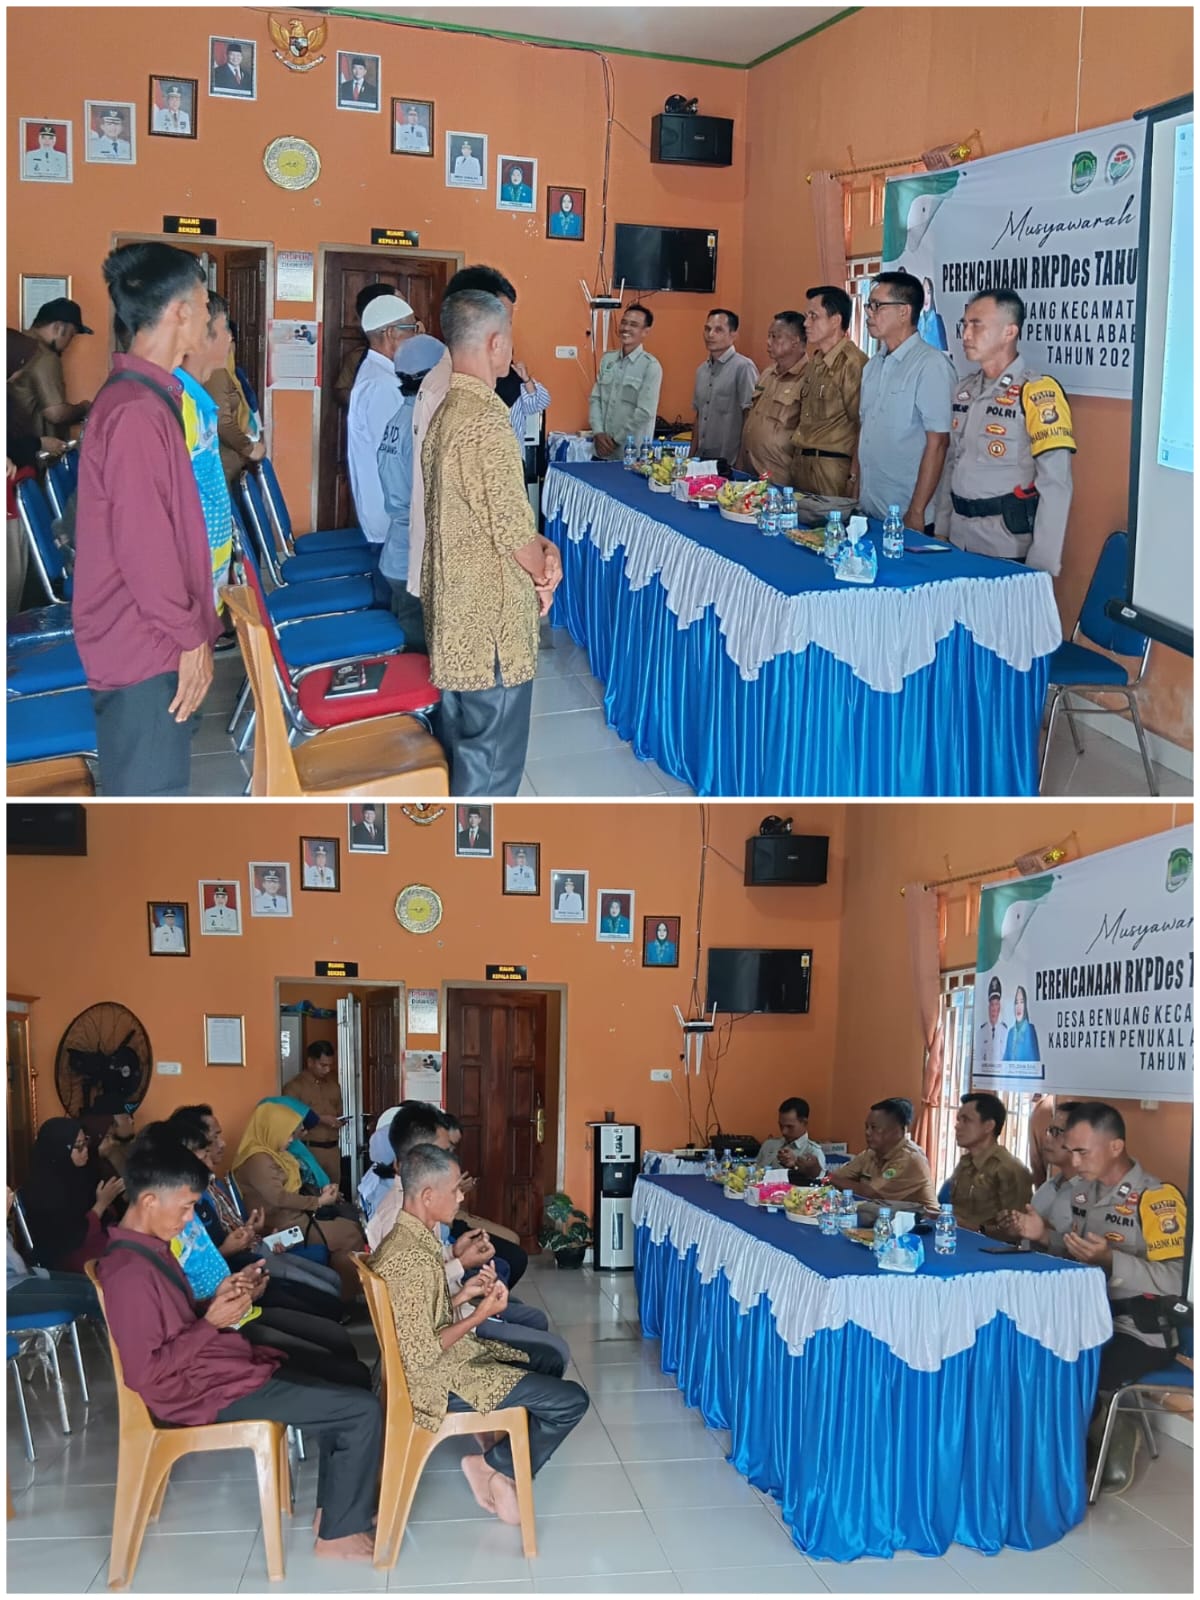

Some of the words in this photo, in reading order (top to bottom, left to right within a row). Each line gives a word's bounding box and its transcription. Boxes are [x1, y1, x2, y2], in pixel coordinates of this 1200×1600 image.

[991, 194, 1136, 250] Musyawarah
[942, 256, 1028, 293] PERENCANAAN
[1031, 253, 1091, 290] RKPDes
[1027, 324, 1091, 343] PENUKAL
[1047, 346, 1094, 366] TAHUN
[986, 406, 1017, 419] POLRI
[1036, 960, 1122, 1001] PERENCANAAN
[1125, 955, 1184, 994] RKPDes
[1057, 1010, 1085, 1028] DESA
[1089, 1006, 1150, 1027] BENUANG
[1048, 1030, 1115, 1049] KABUPATEN
[1120, 1028, 1184, 1048] PENUKAL
[1140, 1052, 1186, 1071] TAHUN
[1105, 1213, 1134, 1227] POLRI
